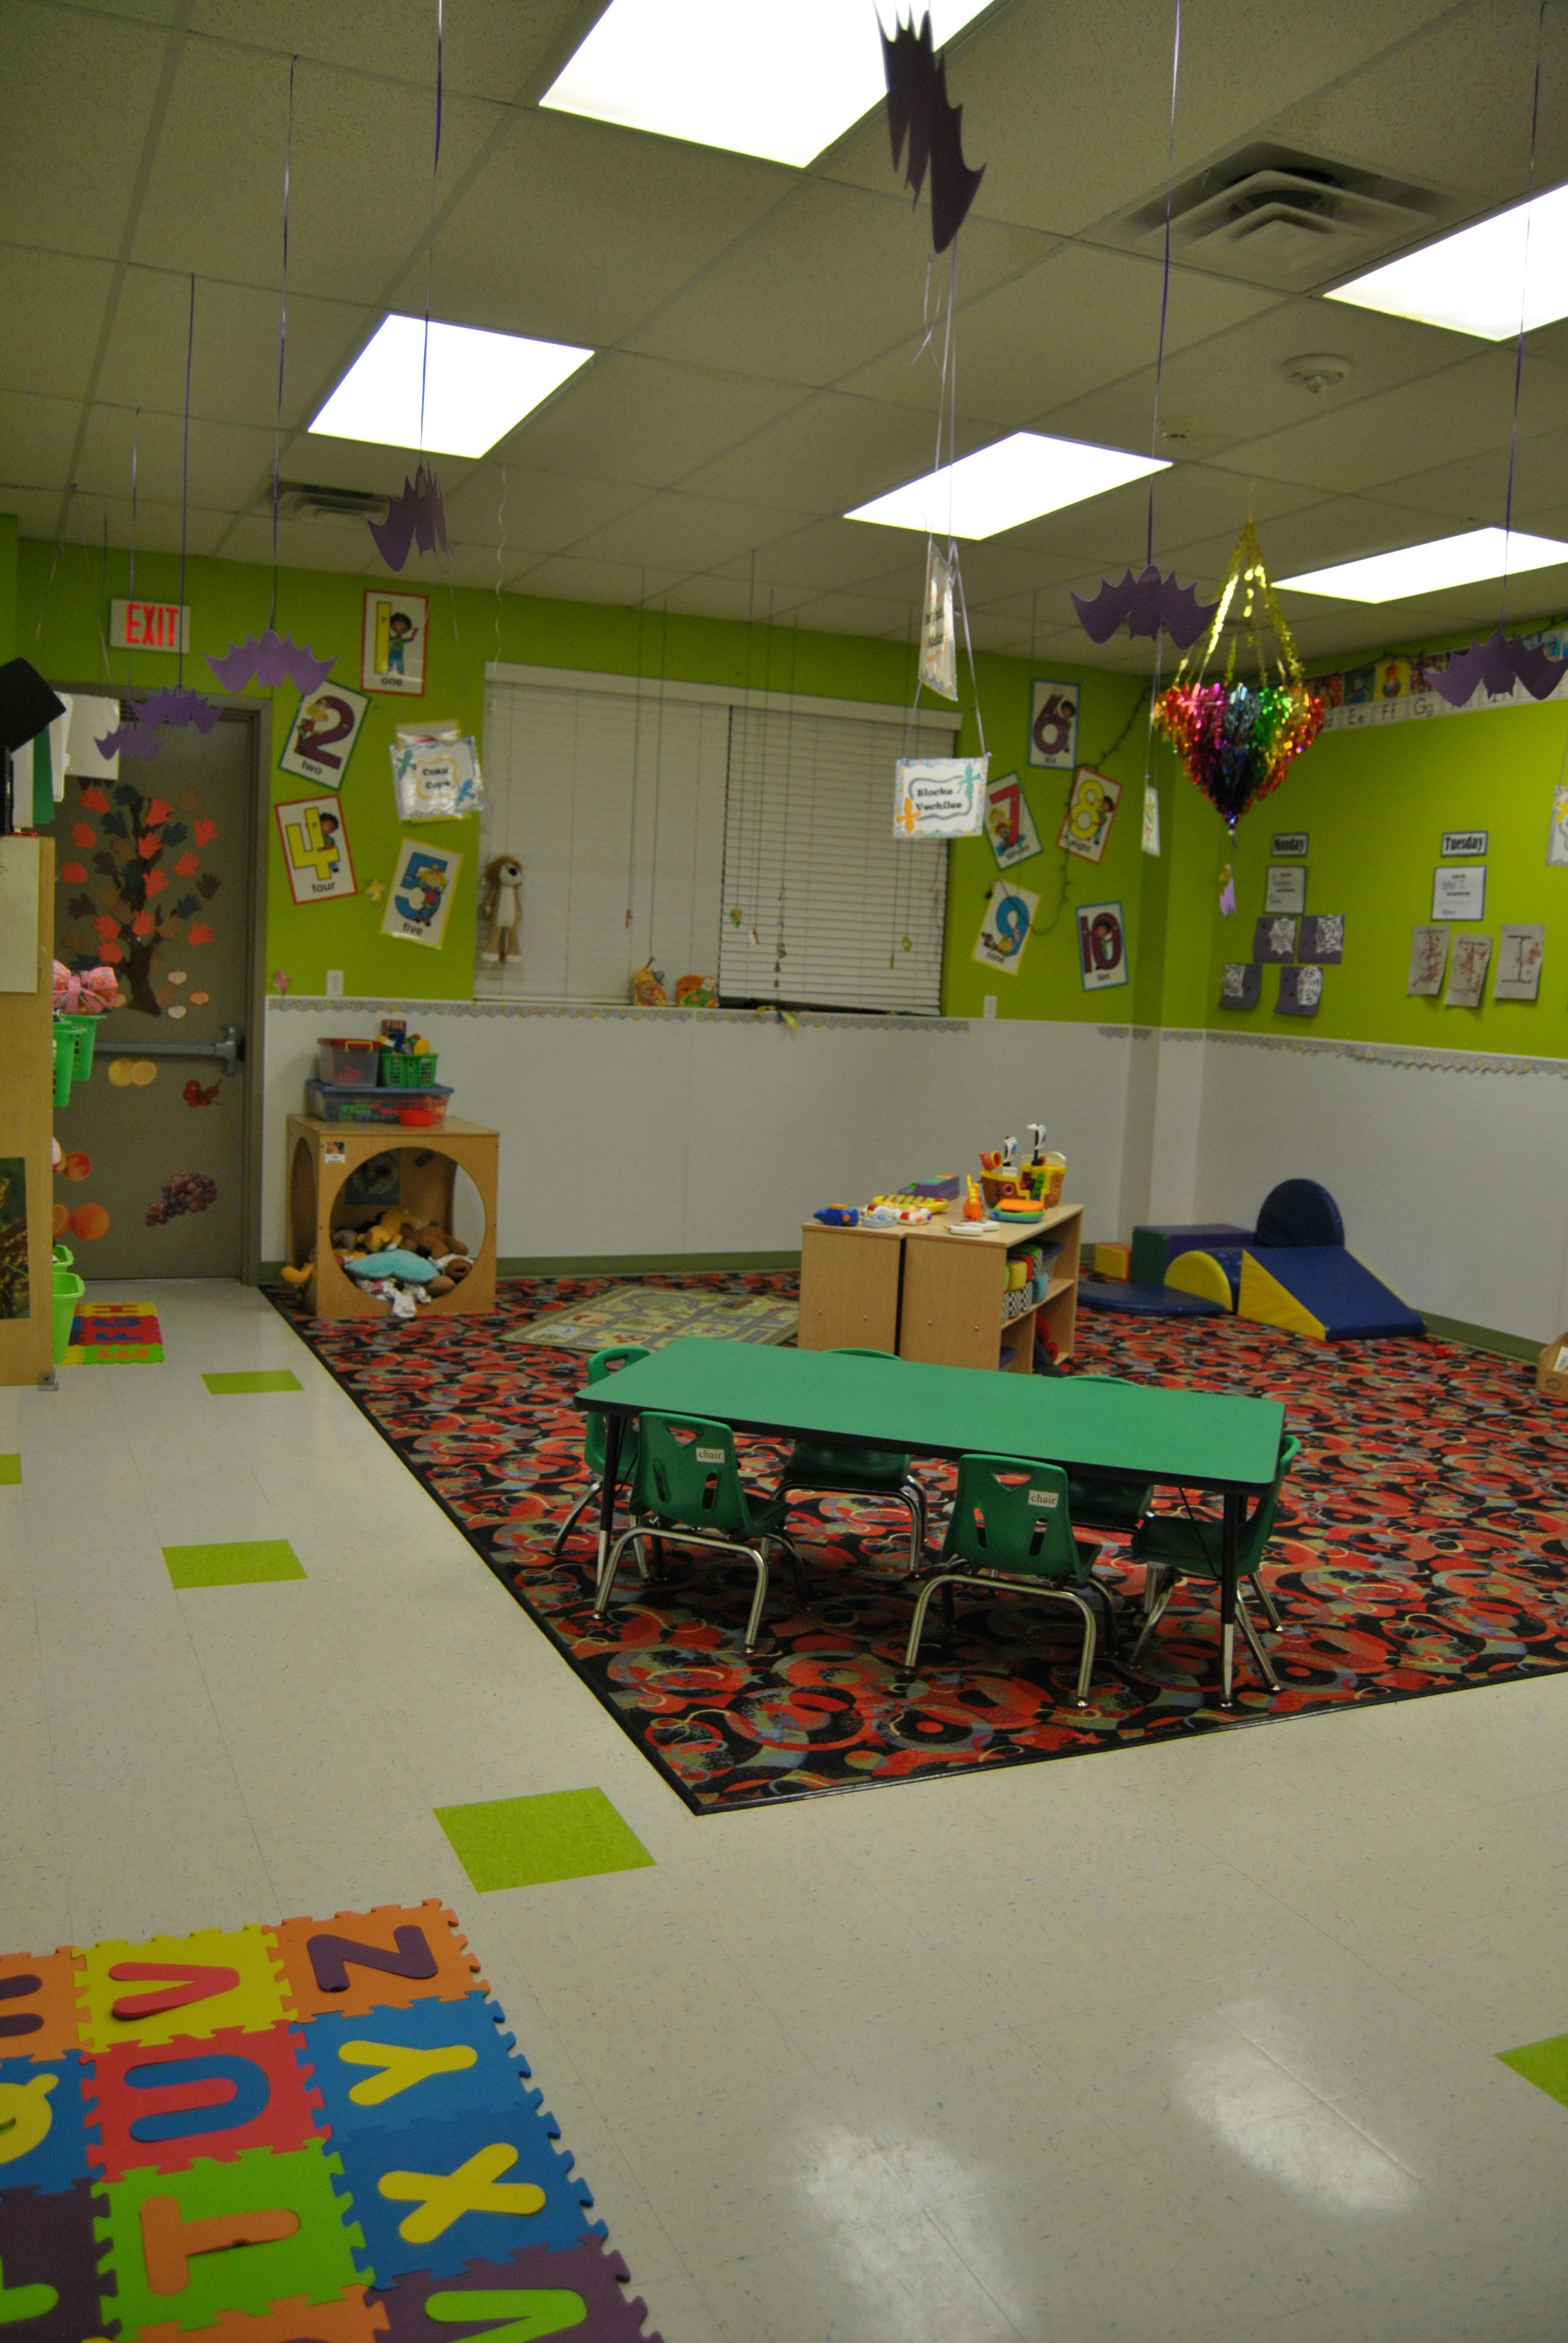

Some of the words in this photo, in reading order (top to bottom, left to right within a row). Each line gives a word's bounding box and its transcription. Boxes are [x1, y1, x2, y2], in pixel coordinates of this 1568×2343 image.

[125, 602, 179, 647] EXIT
[374, 601, 391, 674] 1
[381, 677, 403, 686] one
[1414, 698, 1434, 718] Gg
[296, 695, 355, 770] 2
[1033, 694, 1070, 755] 6
[301, 761, 322, 775] two
[917, 787, 953, 796] Blocks
[989, 783, 1019, 844] 7
[1070, 779, 1104, 840] 8
[286, 807, 339, 880] 4
[1445, 835, 1483, 851] Tuesday
[312, 882, 335, 893] four
[395, 851, 447, 922] 5
[402, 921, 423, 936] five
[996, 896, 1030, 955] 9
[1080, 912, 1122, 973] 10
[987, 951, 1005, 964] nine
[1097, 973, 1111, 981] ten
[387, 1020, 404, 1028] FIRE
[699, 1450, 722, 1459] chair
[1031, 1493, 1056, 1504] chair
[307, 1925, 439, 1993] Z
[109, 1962, 241, 2020] V
[125, 2054, 270, 2143] U
[339, 2040, 477, 2105] Y
[378, 2143, 546, 2243] X
[140, 2195, 300, 2295] T
